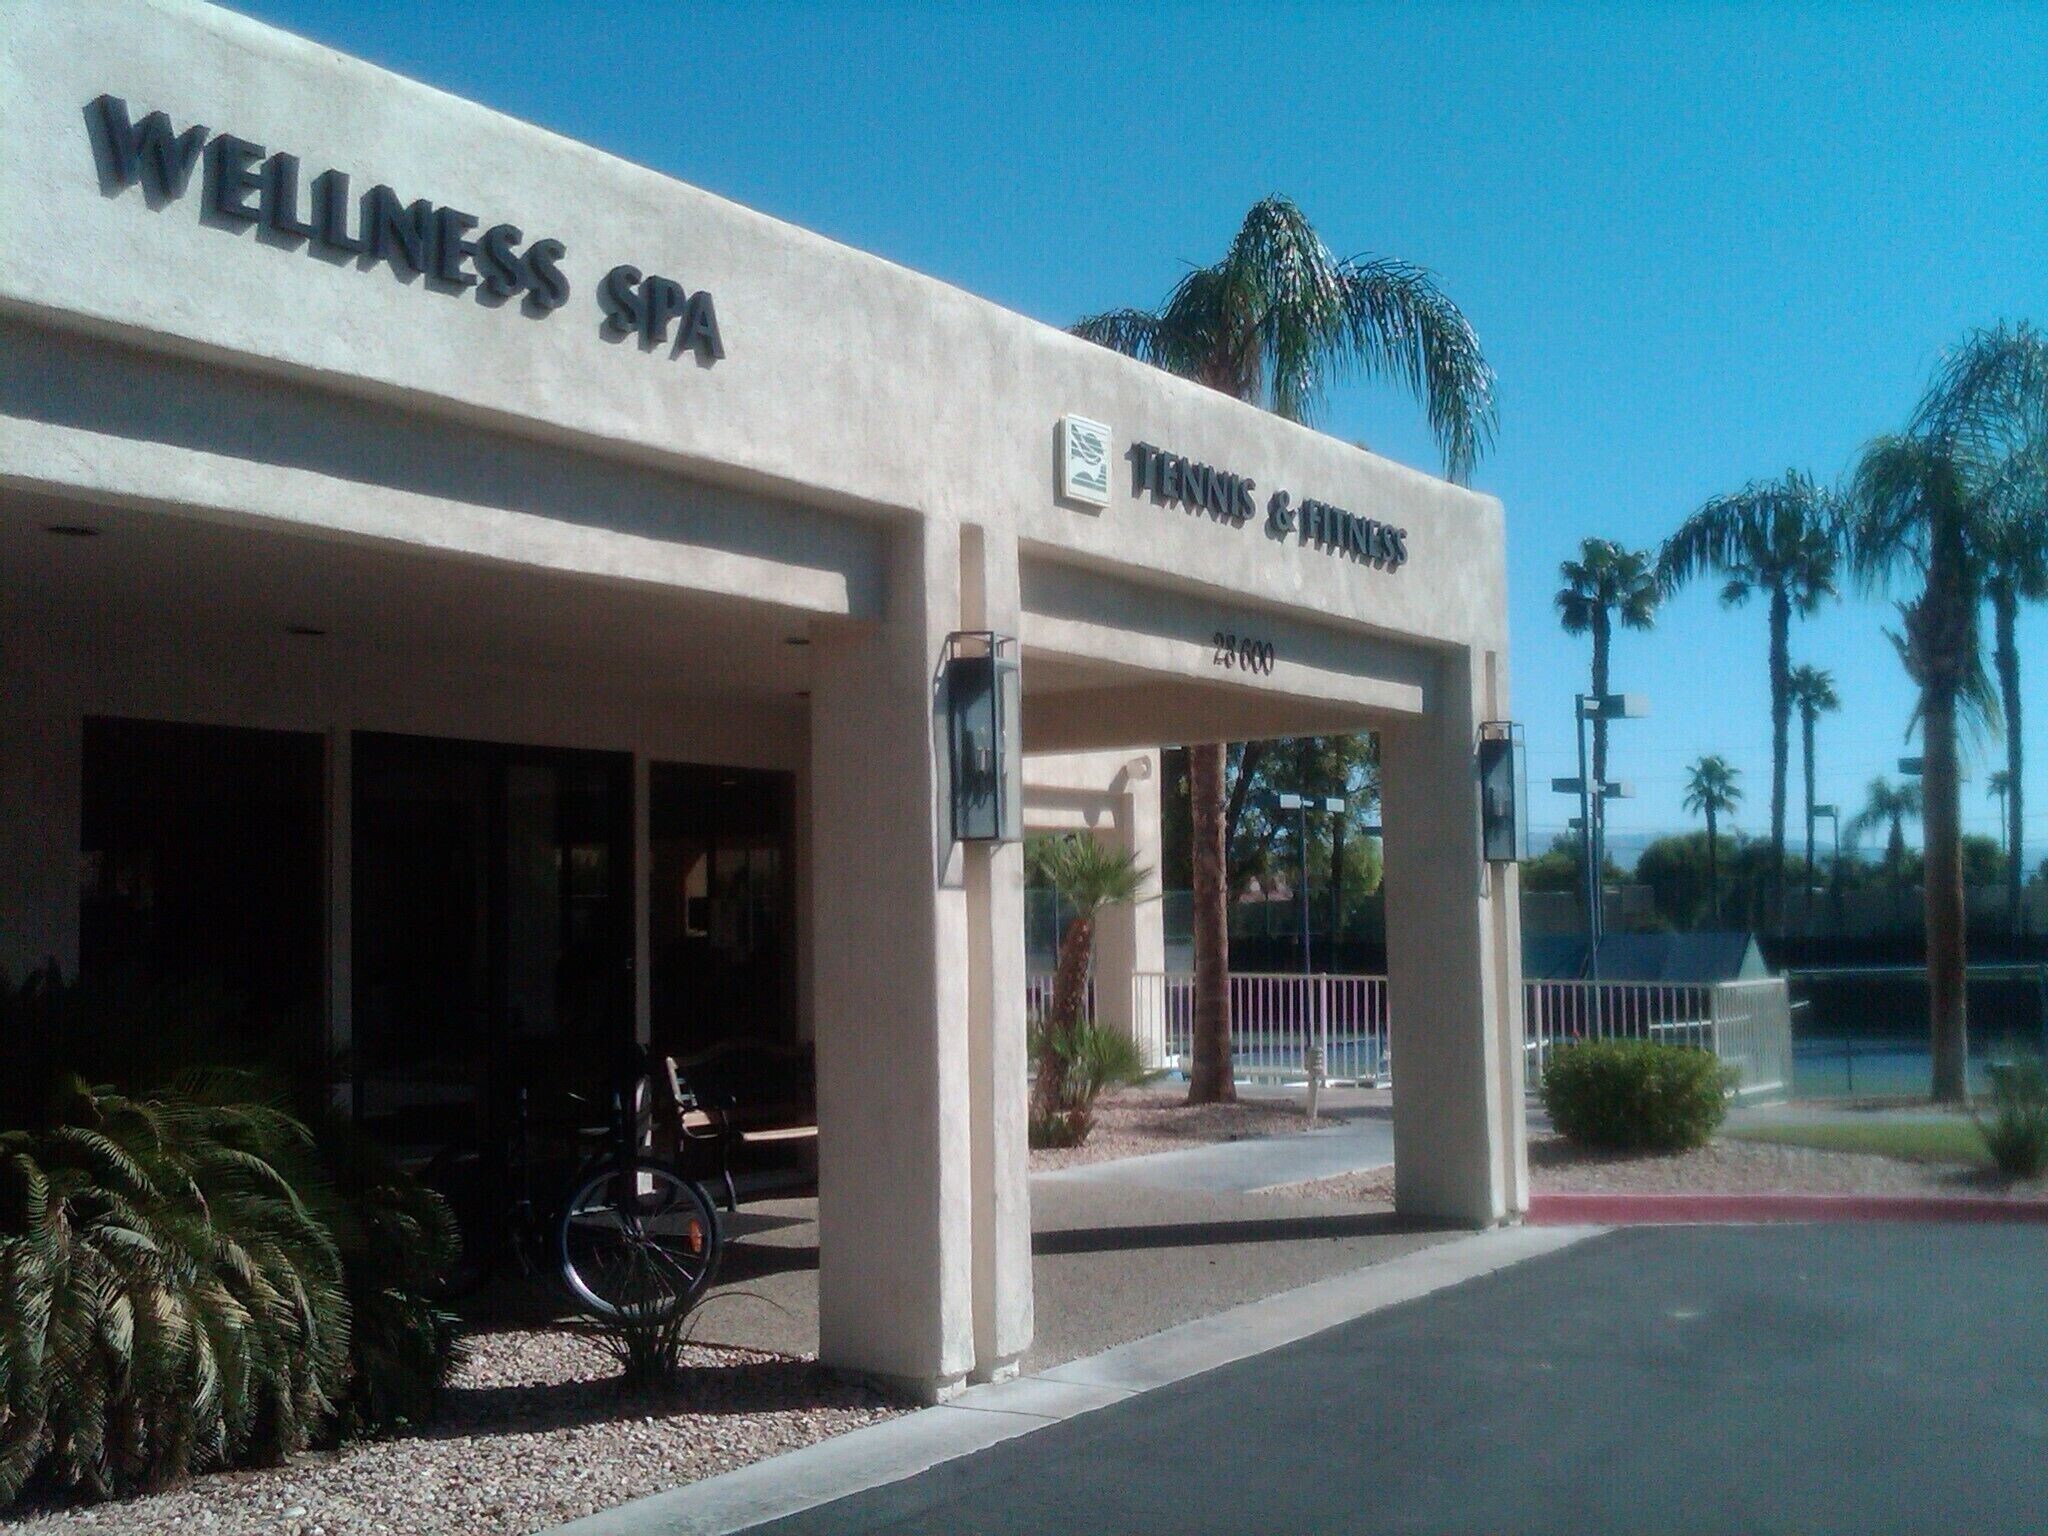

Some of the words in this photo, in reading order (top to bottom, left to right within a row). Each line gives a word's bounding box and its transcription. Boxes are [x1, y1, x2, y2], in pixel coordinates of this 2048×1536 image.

[83, 94, 571, 320] WELLNESS
[596, 265, 725, 369] SPA
[1127, 441, 1256, 529] TENNIS
[1266, 489, 1297, 541] &
[1300, 498, 1409, 573] FITNESS
